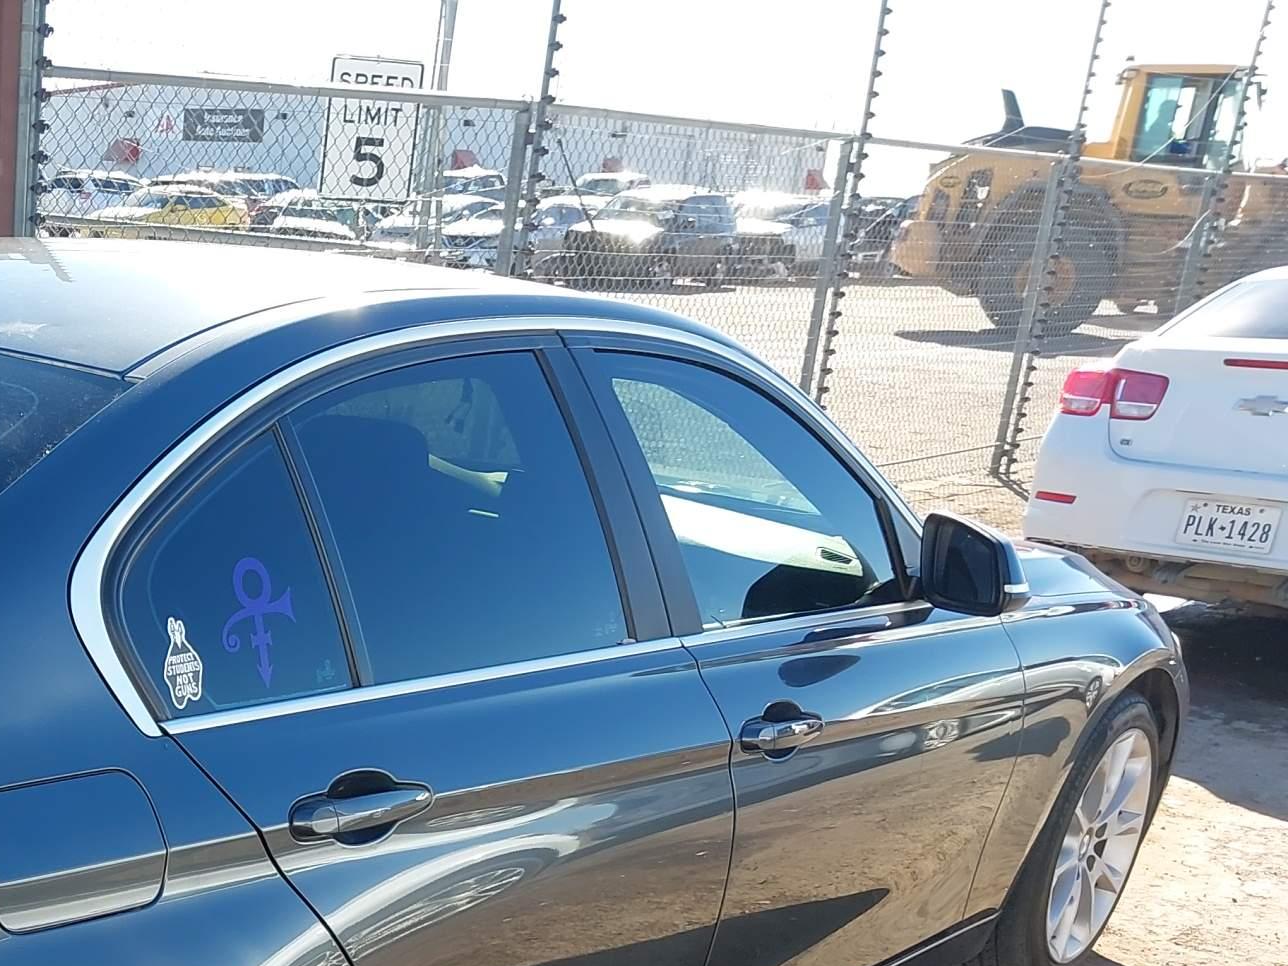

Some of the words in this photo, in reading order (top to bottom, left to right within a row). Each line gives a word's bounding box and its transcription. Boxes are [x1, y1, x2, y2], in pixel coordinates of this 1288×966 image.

[340, 71, 414, 88] SPEED
[343, 105, 403, 127] LIMIT
[350, 136, 385, 188] 5
[1215, 504, 1252, 516] TEXAS
[168, 653, 195, 665] PROTECT
[167, 661, 200, 676] STUDENTS
[176, 673, 194, 685] NOT
[175, 683, 198, 697] GUNS
